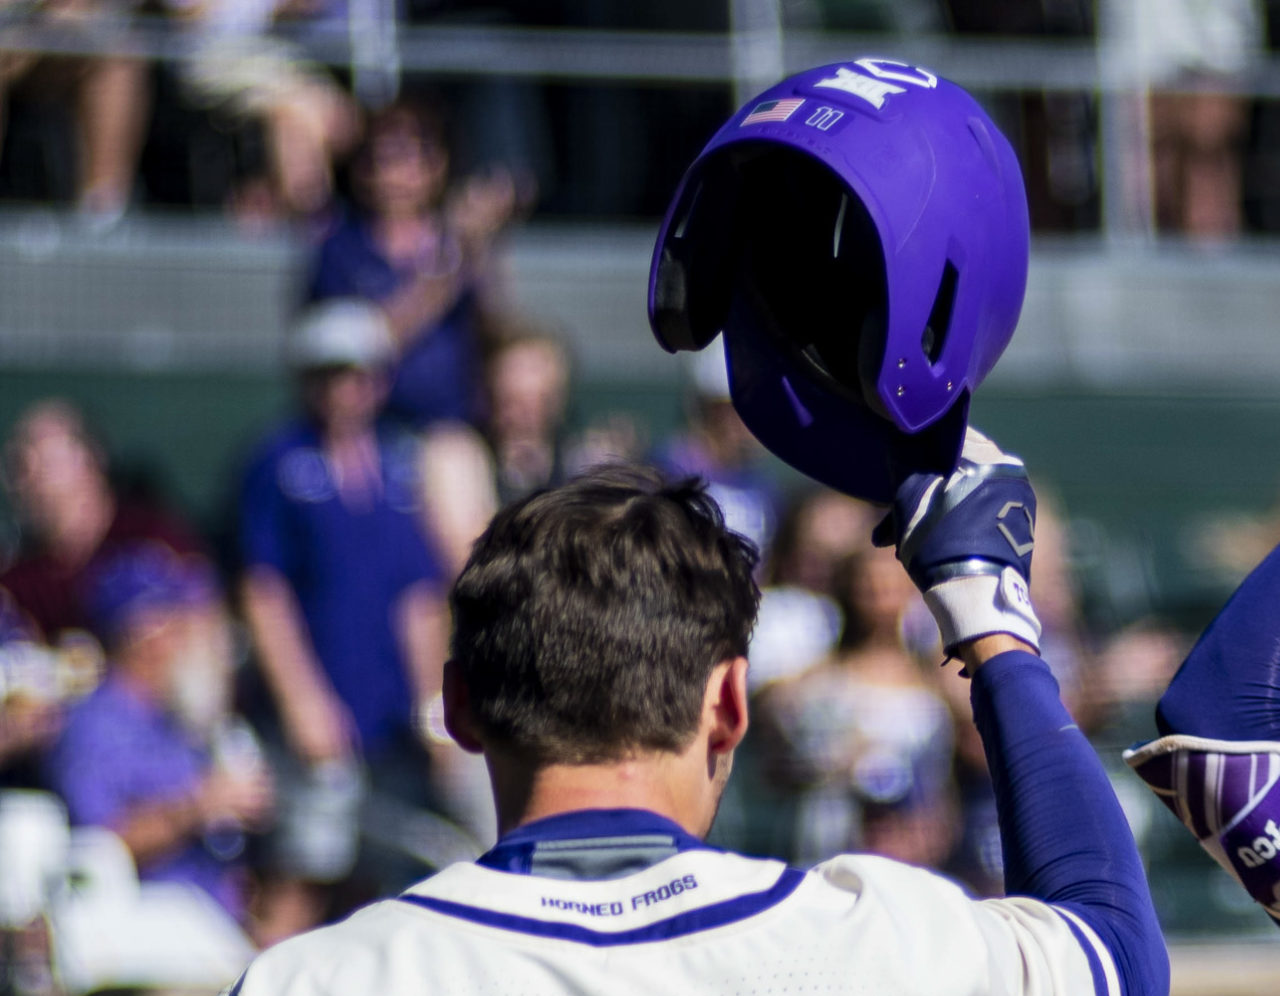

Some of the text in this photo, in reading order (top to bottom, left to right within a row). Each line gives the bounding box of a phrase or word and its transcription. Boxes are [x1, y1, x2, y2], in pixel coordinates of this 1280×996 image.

[805, 106, 844, 131] 11
[541, 874, 698, 917] HORNED FROGS
